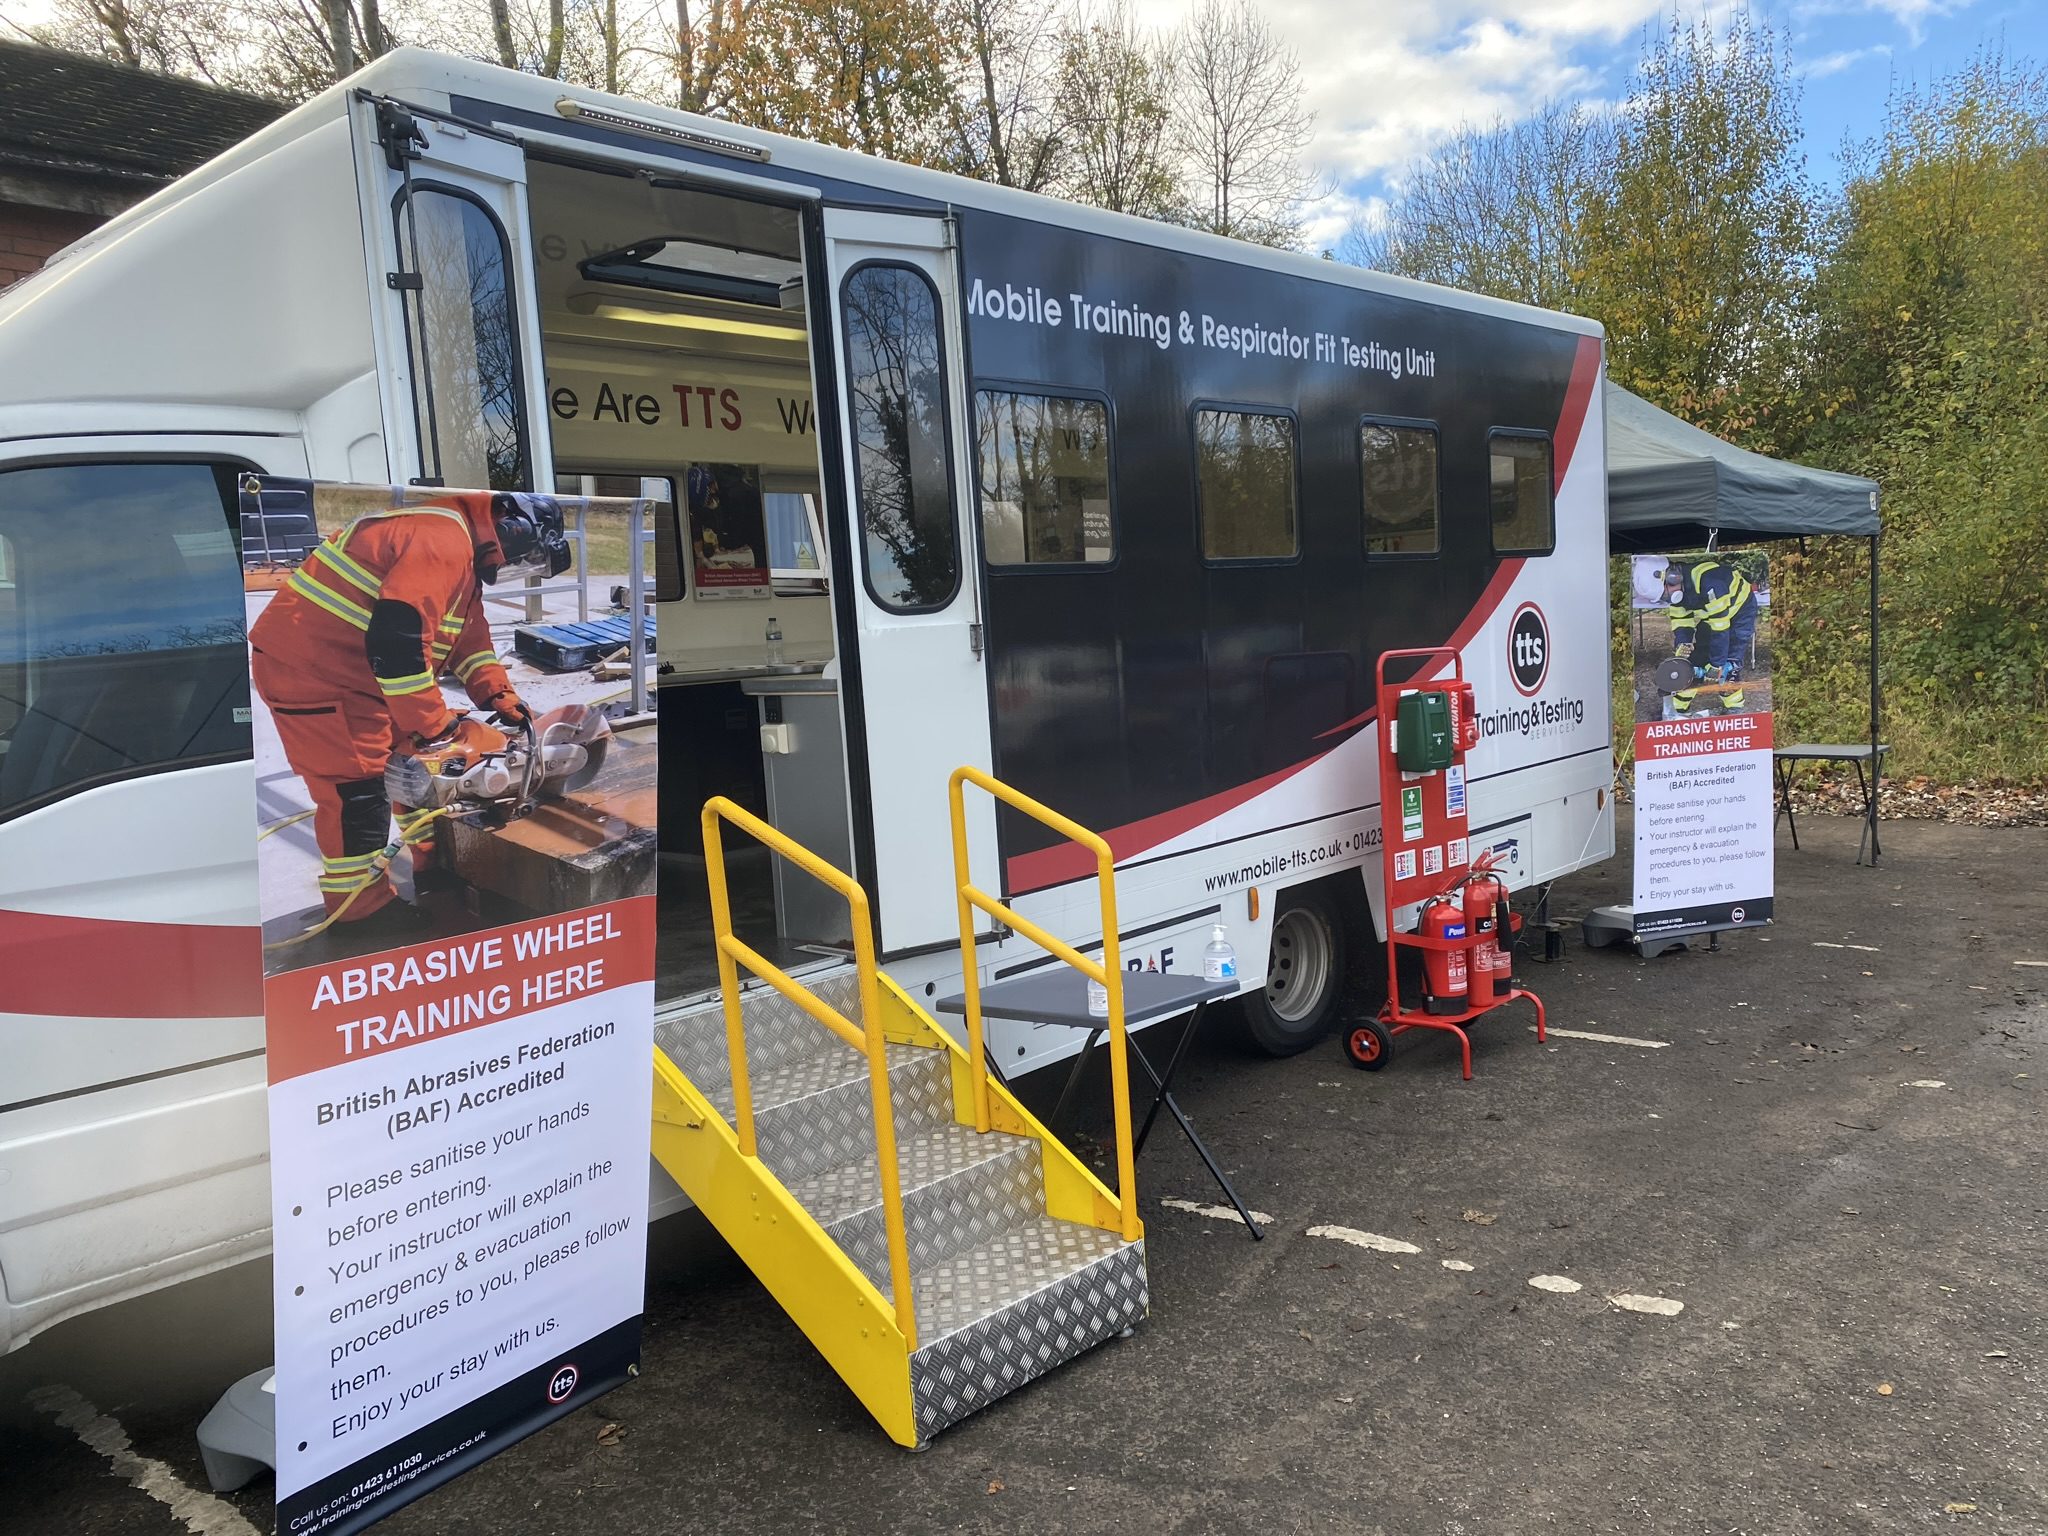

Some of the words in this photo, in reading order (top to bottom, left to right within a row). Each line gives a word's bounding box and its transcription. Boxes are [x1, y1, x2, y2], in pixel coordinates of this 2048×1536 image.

[966, 278, 1062, 326] Mobile
[1070, 293, 1171, 350] Training
[1178, 311, 1195, 344] &
[1202, 314, 1310, 359] Respirator
[1315, 332, 1336, 363] Fit
[1341, 336, 1401, 379] Testing
[1406, 346, 1436, 378] Unit
[593, 382, 660, 425] Are
[672, 384, 742, 431] TTS
[1516, 632, 1543, 668] tts
[1451, 691, 1459, 744] EVACUATOR
[1531, 722, 1576, 740] SERVICES
[1646, 721, 1710, 738] ABRASIVE
[1714, 717, 1757, 733] WHEEL
[1654, 740, 1713, 757] TRAINING
[1717, 736, 1750, 750] HERE
[1647, 771, 1672, 781] British
[1675, 765, 1713, 778] Abrasives
[1716, 762, 1756, 773] Federation
[1669, 780, 1692, 791] (BAF)
[1693, 776, 1735, 787] Accredited
[1649, 801, 1675, 812] Please
[1676, 798, 1704, 809] sanitise
[1706, 798, 1722, 808] your
[1723, 794, 1746, 804] hands
[1650, 817, 1673, 826] before
[1650, 832, 1667, 841] Your
[1669, 827, 1703, 838] instructor
[1705, 827, 1716, 835] will
[1718, 824, 1744, 833] explain
[1650, 845, 1690, 856] emergency
[1693, 842, 1698, 850] &
[1700, 839, 1739, 850] evacuation
[1205, 839, 1342, 892] www.mobile-tts.co.uk
[1353, 828, 1382, 851] 01423
[1650, 858, 1691, 870] procedures
[1693, 857, 1700, 865] to
[1719, 853, 1743, 863] please
[1745, 850, 1766, 858] follow
[1650, 876, 1670, 885] them.
[1650, 890, 1671, 901] Enjoy
[1673, 887, 1690, 897] your
[1691, 885, 1706, 895] stay
[1708, 883, 1723, 892] with
[1725, 882, 1736, 890] us.
[310, 937, 502, 1011] ABRASIVE
[513, 911, 621, 960] WHEEL
[336, 984, 511, 1055] TRAINING
[522, 958, 604, 1006] HERE
[316, 1085, 397, 1126] British
[403, 1055, 510, 1099] Abrasives
[517, 1020, 615, 1064] Federation
[387, 1099, 450, 1139] (BAF)
[457, 1062, 565, 1114] Accredited
[327, 1166, 403, 1208] Please
[410, 1136, 487, 1178] sanitise
[492, 1123, 532, 1156] your
[538, 1100, 590, 1133] hands
[328, 1211, 398, 1248] before
[405, 1178, 492, 1218] entering.
[328, 1250, 382, 1285] Your
[388, 1211, 484, 1262] instructor
[488, 1195, 517, 1221] will
[522, 1171, 583, 1210] explain
[588, 1159, 613, 1185] the
[329, 1262, 449, 1325] emergency
[454, 1251, 469, 1271] &
[474, 1210, 571, 1263] evacuation
[330, 1298, 450, 1366] procedures
[455, 1286, 473, 1307] to
[479, 1270, 518, 1301] you,
[523, 1241, 580, 1280] please
[585, 1217, 631, 1249] follow
[330, 1367, 391, 1401] them.
[332, 1397, 392, 1440] Enjoy
[400, 1371, 444, 1411] your
[449, 1350, 488, 1383] stay
[494, 1328, 530, 1358] with
[535, 1317, 560, 1333] us.
[554, 1373, 574, 1393] tts
[290, 1510, 313, 1530] Call
[316, 1504, 328, 1516] us
[330, 1493, 349, 1508] on:
[351, 1473, 384, 1497] 01423
[386, 1452, 423, 1478] 611030
[297, 1430, 486, 1536] ww.trainingandtestingservices.co.uk
